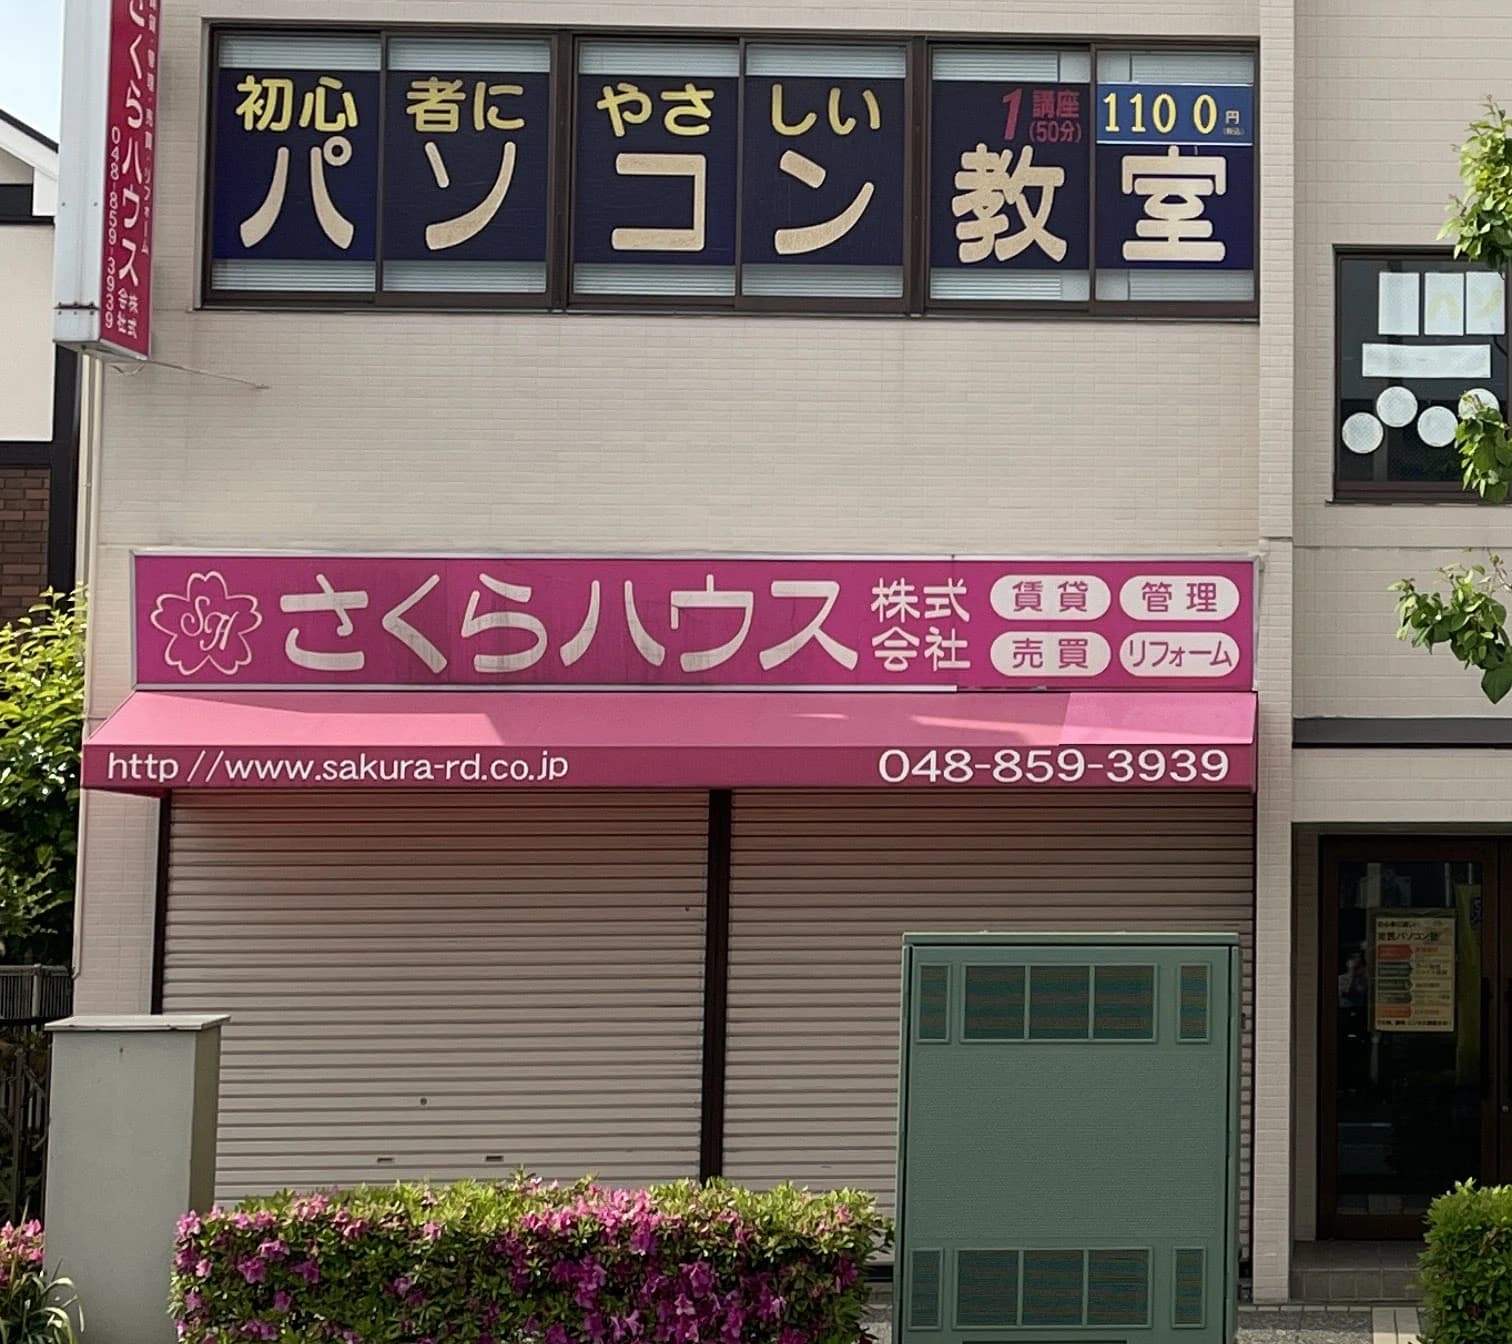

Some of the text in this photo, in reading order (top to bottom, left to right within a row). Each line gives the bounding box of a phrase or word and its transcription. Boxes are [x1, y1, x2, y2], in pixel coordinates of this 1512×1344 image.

[235, 74, 882, 137] 初心者にやさしい
[1029, 120, 1082, 144] (50分)
[240, 135, 1227, 262] パソコン教室
[104, 126, 121, 329] 048-859-3939
[870, 577, 971, 623] 株式
[1011, 580, 1089, 613] 賃貸
[1141, 581, 1218, 613] 管理
[280, 573, 858, 673] さくらハウス
[871, 626, 971, 672] 会社
[1011, 637, 1090, 670] 売買
[1128, 640, 1233, 668] リフォーム
[107, 749, 569, 784] http//www.sakura-rd.co.jp
[878, 749, 1230, 784] 048-859-3939
